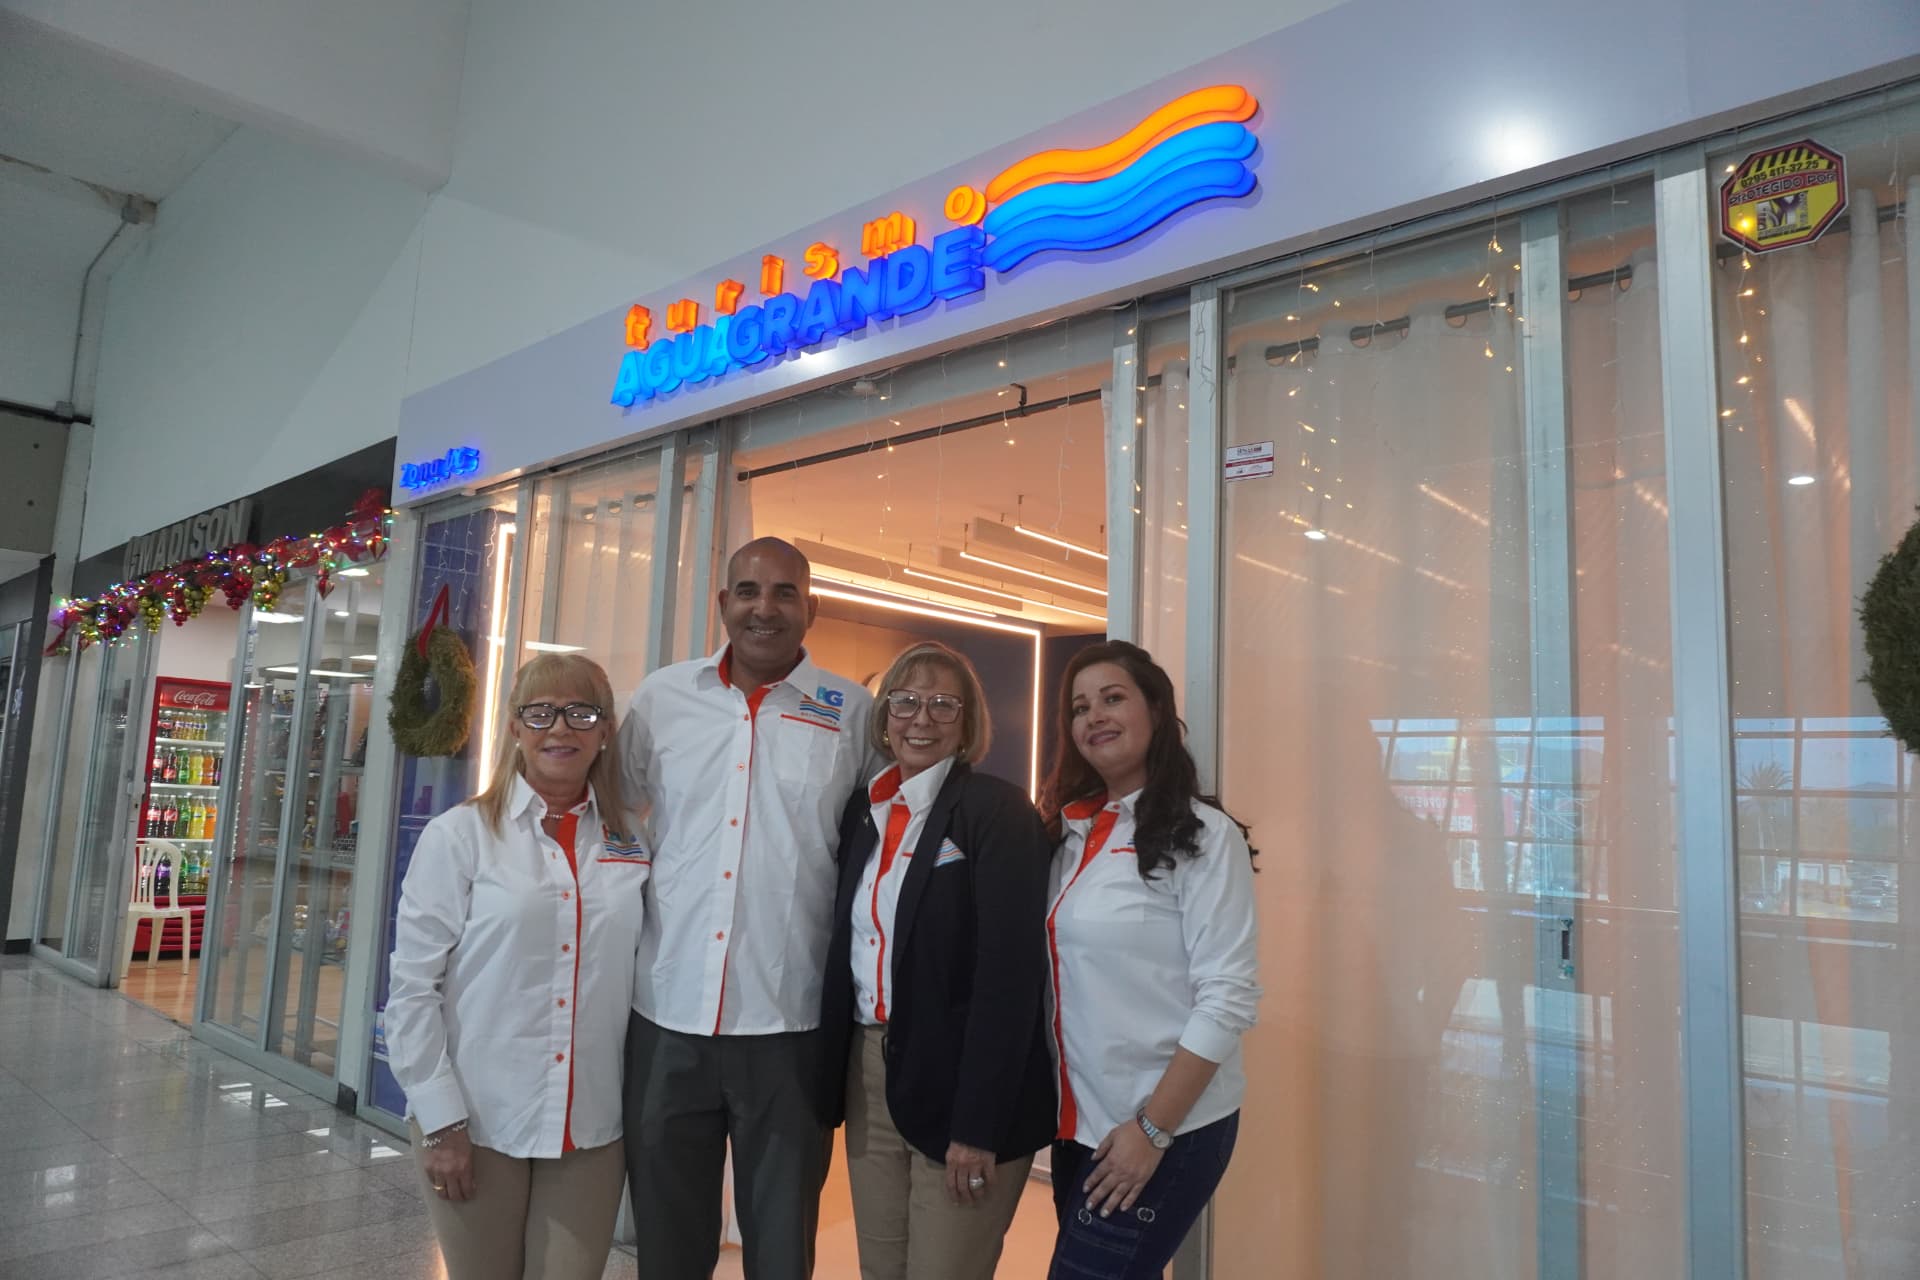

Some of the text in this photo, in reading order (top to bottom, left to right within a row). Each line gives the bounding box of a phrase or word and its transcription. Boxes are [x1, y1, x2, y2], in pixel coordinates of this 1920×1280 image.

[625, 185, 986, 350] turismo
[1728, 172, 1836, 205] PROTEGIDO POR
[611, 224, 987, 407] AGUAGRANDE
